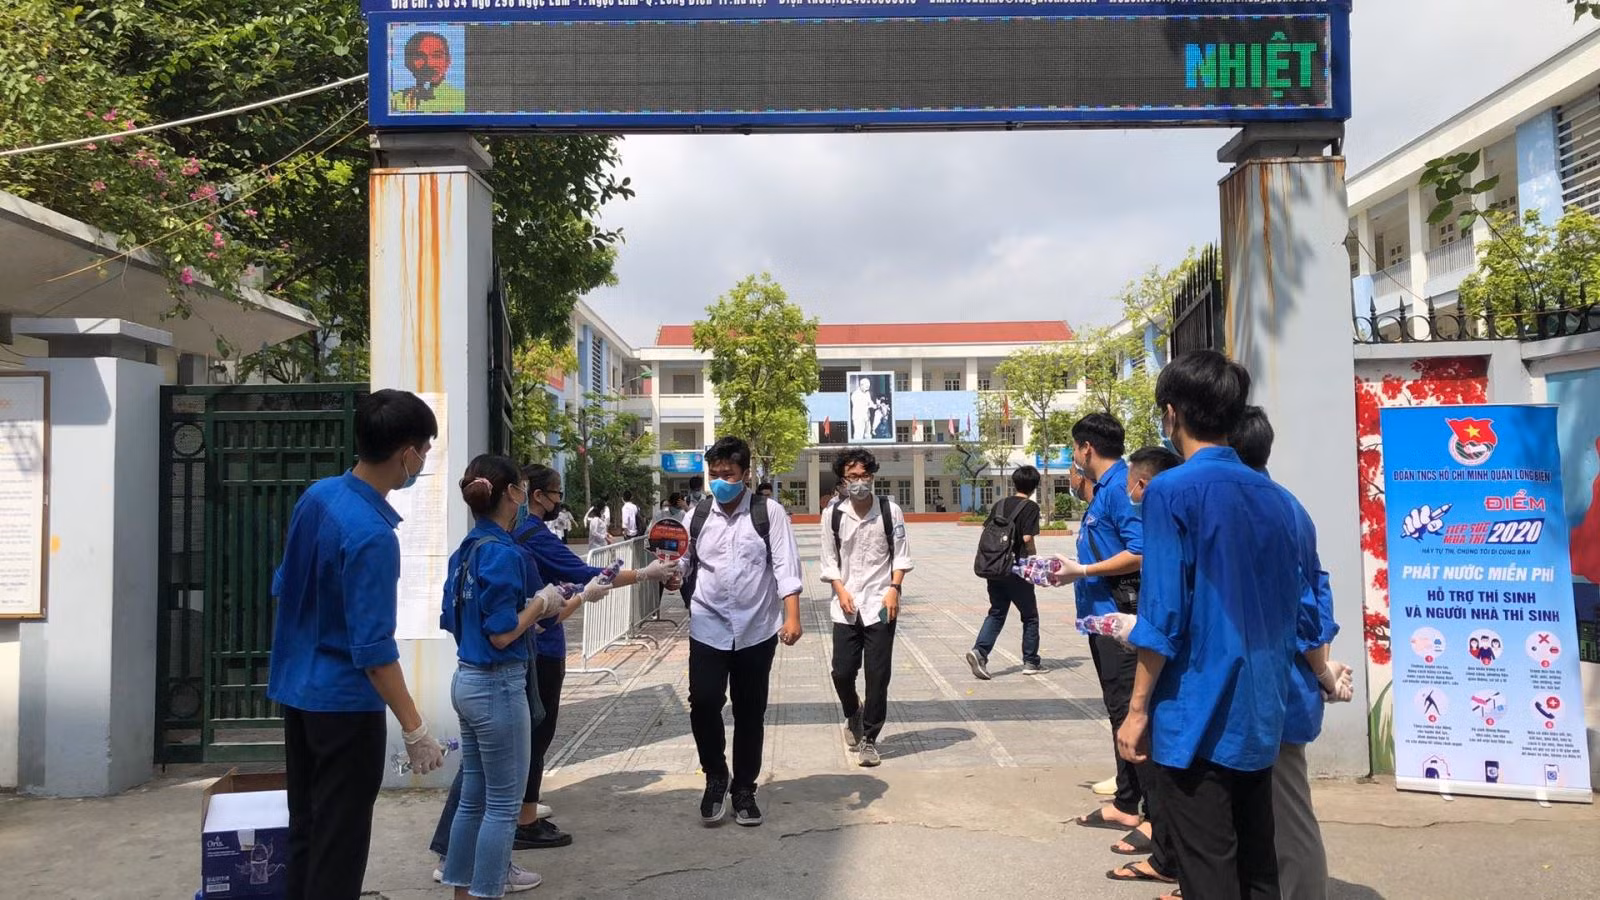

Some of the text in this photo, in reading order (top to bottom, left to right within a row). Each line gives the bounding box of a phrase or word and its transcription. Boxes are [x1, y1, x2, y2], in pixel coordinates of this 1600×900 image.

[1184, 31, 1317, 98] NHIỆT
[1417, 469, 1438, 481] TNCS
[1467, 469, 1489, 481] MINH
[1484, 489, 1546, 512] ĐIỂM
[1487, 521, 1543, 543] 2020
[1402, 563, 1440, 580] PHÁT
[1443, 563, 1484, 580] NƯỚC
[1531, 565, 1554, 582] PHÍ
[1427, 586, 1536, 605] HỖ TRỢ THÍ SINH
[1405, 604, 1560, 622] VÀ NGƯỜI NHÀ THÍ SINH
